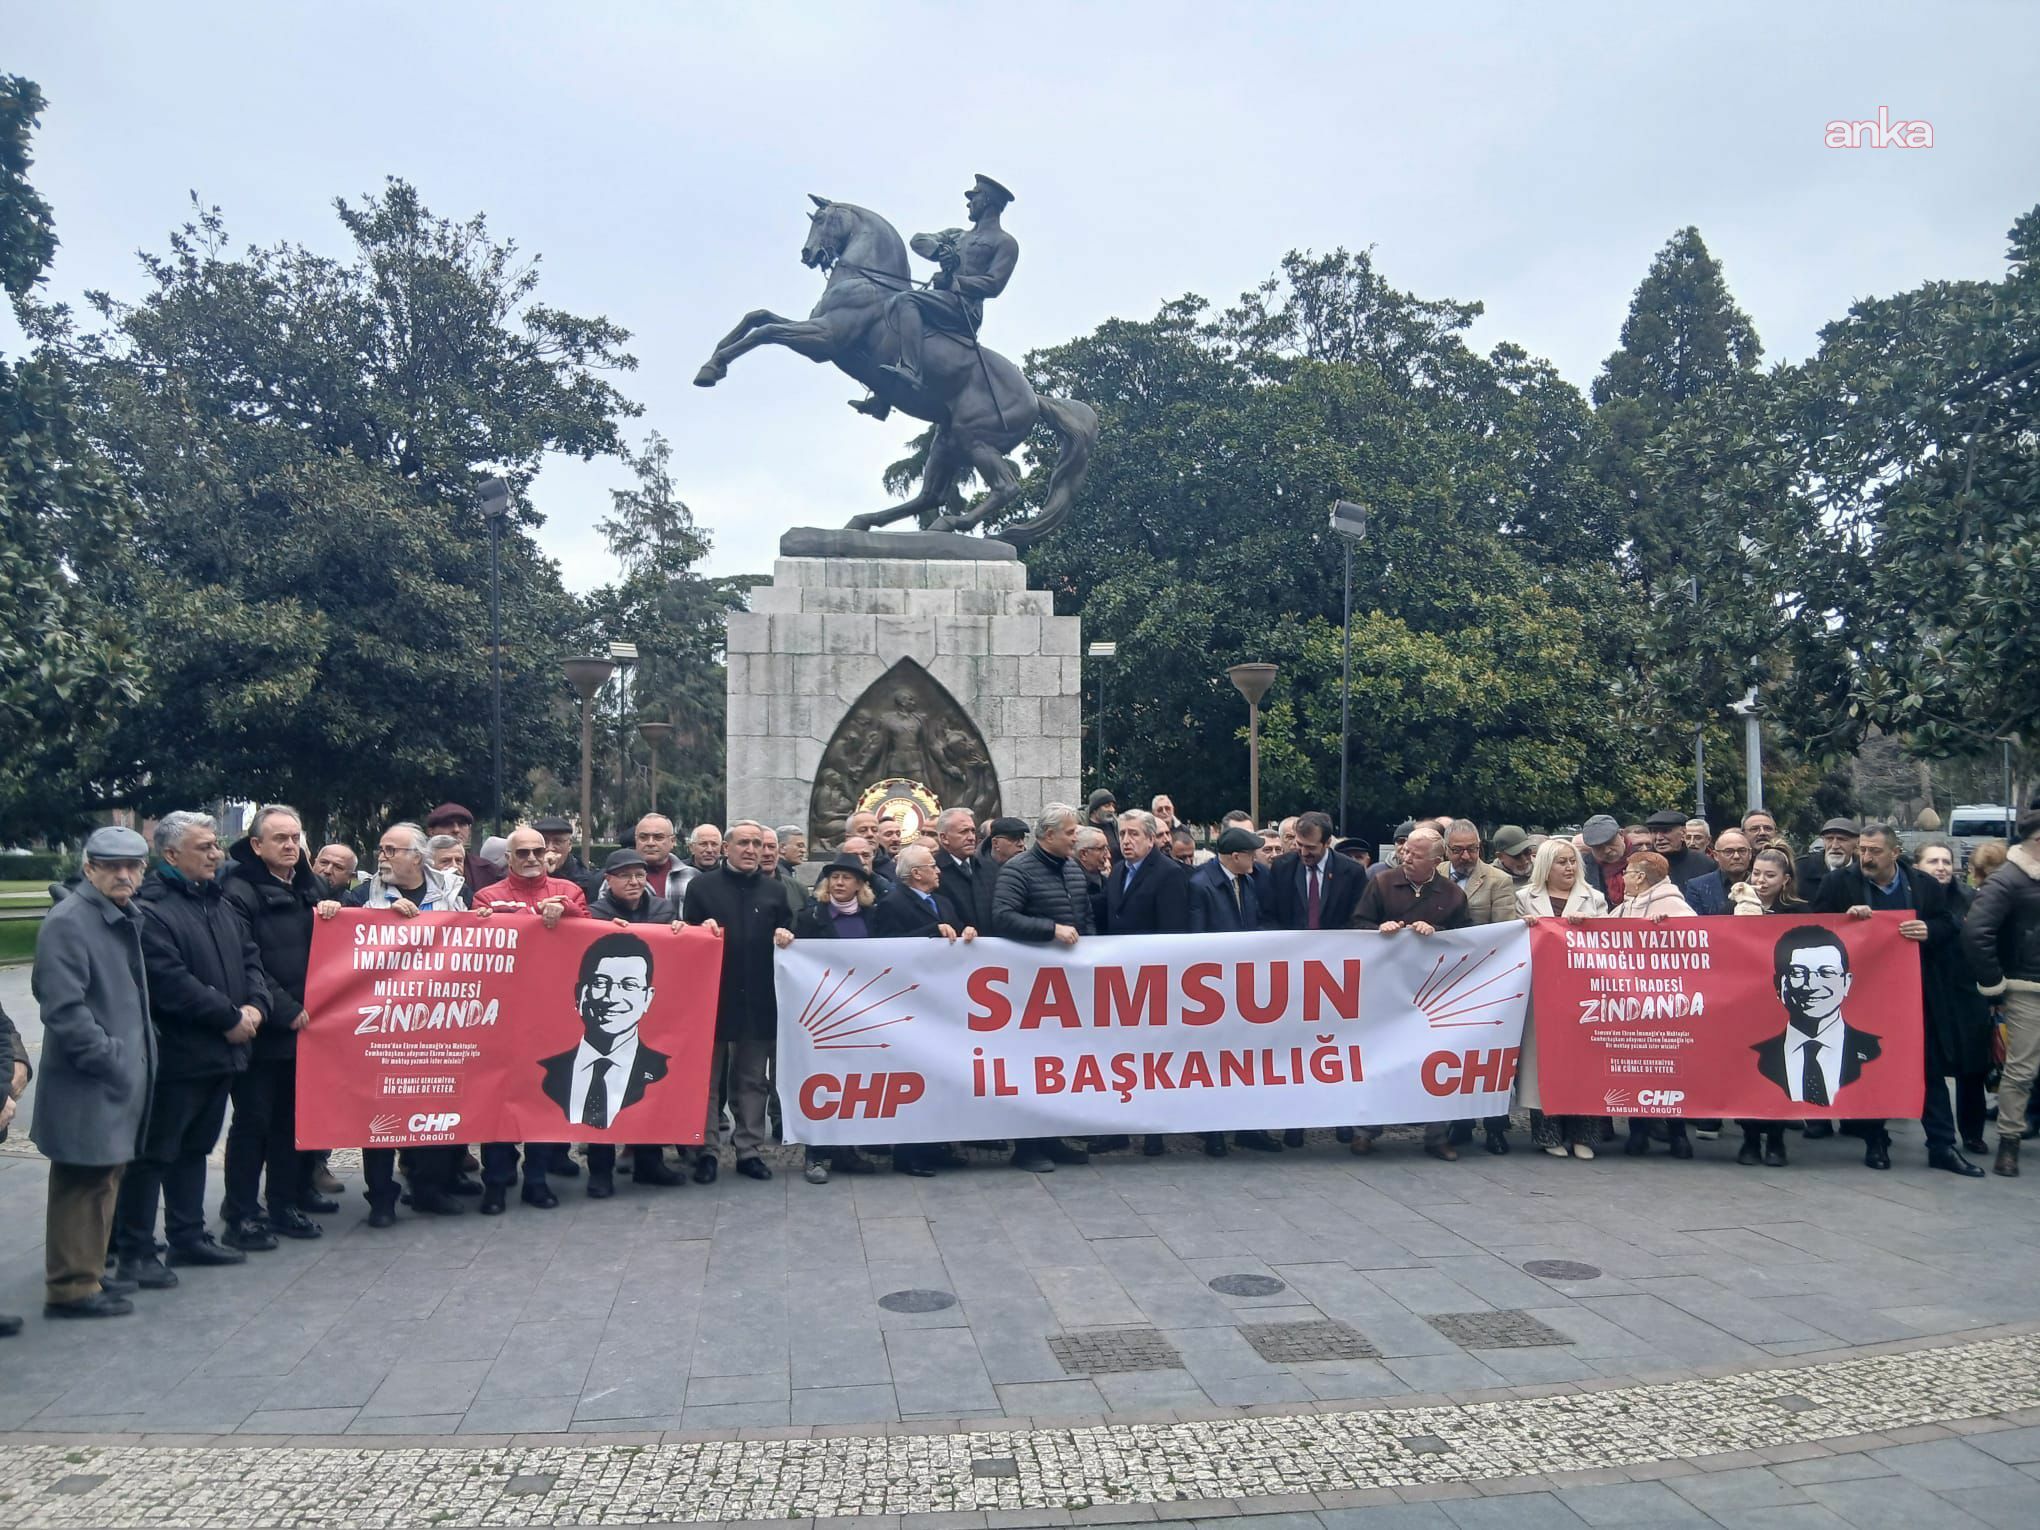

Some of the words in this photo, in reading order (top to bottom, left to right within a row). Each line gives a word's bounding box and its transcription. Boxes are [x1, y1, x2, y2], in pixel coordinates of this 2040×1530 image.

[354, 923, 435, 946] SAMSUN
[441, 926, 519, 949] YAZIYOR
[1565, 930, 1633, 949] SAMSUN
[1638, 929, 1709, 949] YAZIYOR
[353, 947, 445, 971] İMAMOĞLU
[450, 952, 515, 973] OKUYOR
[1567, 950, 1645, 970] İMAMOĞLU
[1650, 953, 1711, 970] OKUYOR
[374, 978, 424, 997] MİLLET
[427, 978, 482, 998] İRADESİ
[1590, 976, 1632, 992] MİLLET
[1634, 976, 1683, 992] İRADESİ
[967, 959, 1361, 1032] SAMSUN
[354, 998, 500, 1035] ZİNDANDA
[1579, 991, 1705, 1024] ZİNDANDA
[972, 1047, 1018, 1097] İL
[1033, 1033, 1364, 1103] BAŞKANLIĞI
[421, 1085, 431, 1093] DE
[432, 1084, 455, 1093] YETER.
[799, 1071, 926, 1121] CHP
[1637, 1090, 1685, 1105] CHP
[1650, 1106, 1682, 1114] ÖRGÜTÜ
[408, 1113, 461, 1132] CHP
[369, 1135, 407, 1143] SAMSUN
[409, 1134, 417, 1142] İL
[420, 1133, 455, 1141] ÖRGÜTÜ
